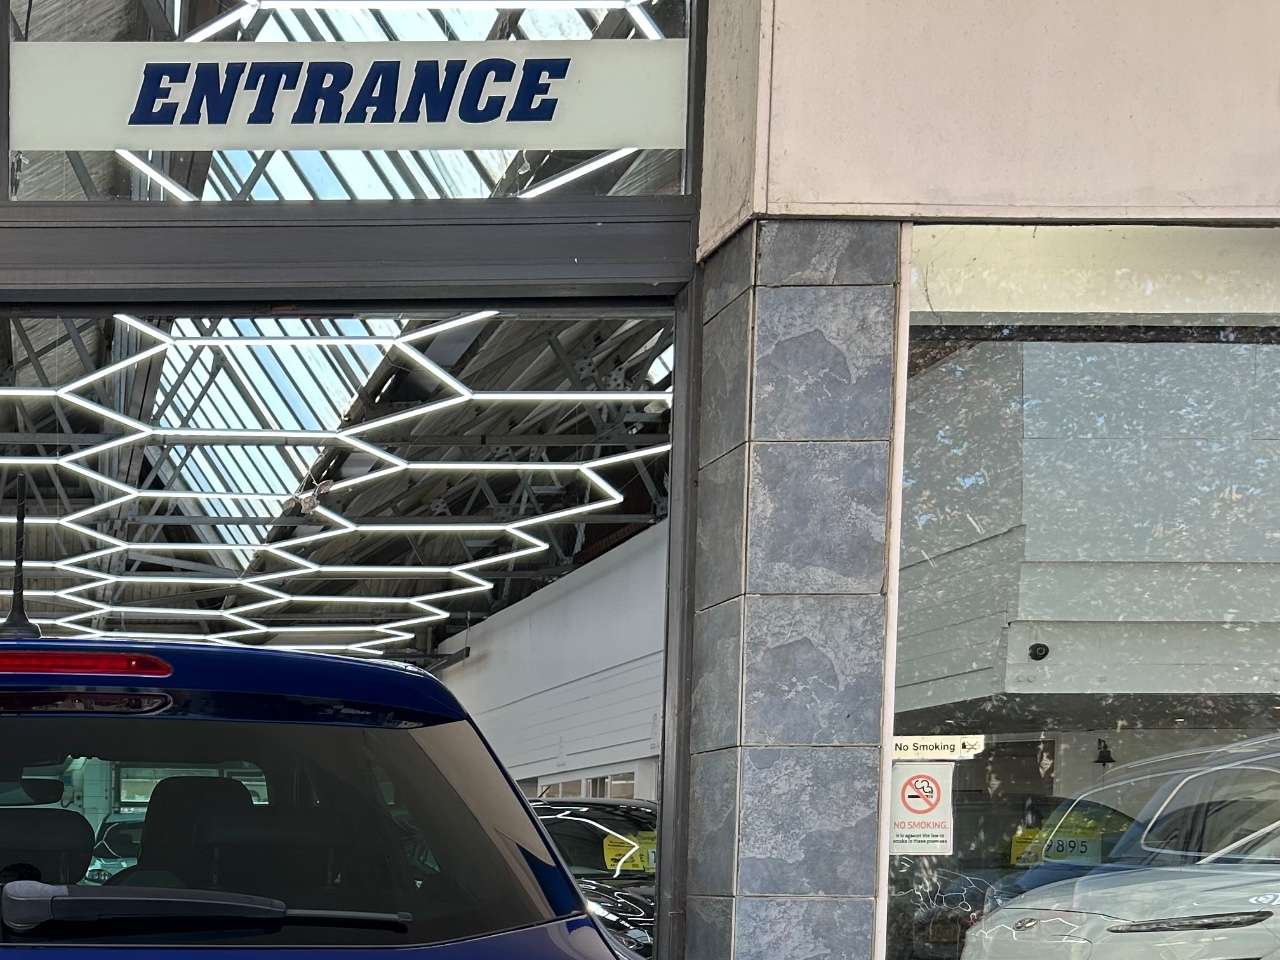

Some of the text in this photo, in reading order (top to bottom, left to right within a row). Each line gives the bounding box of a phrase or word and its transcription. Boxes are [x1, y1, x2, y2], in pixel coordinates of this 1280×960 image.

[127, 58, 570, 126] ENTRANCE
[894, 742, 956, 753] No Smoking
[894, 821, 906, 830] NO
